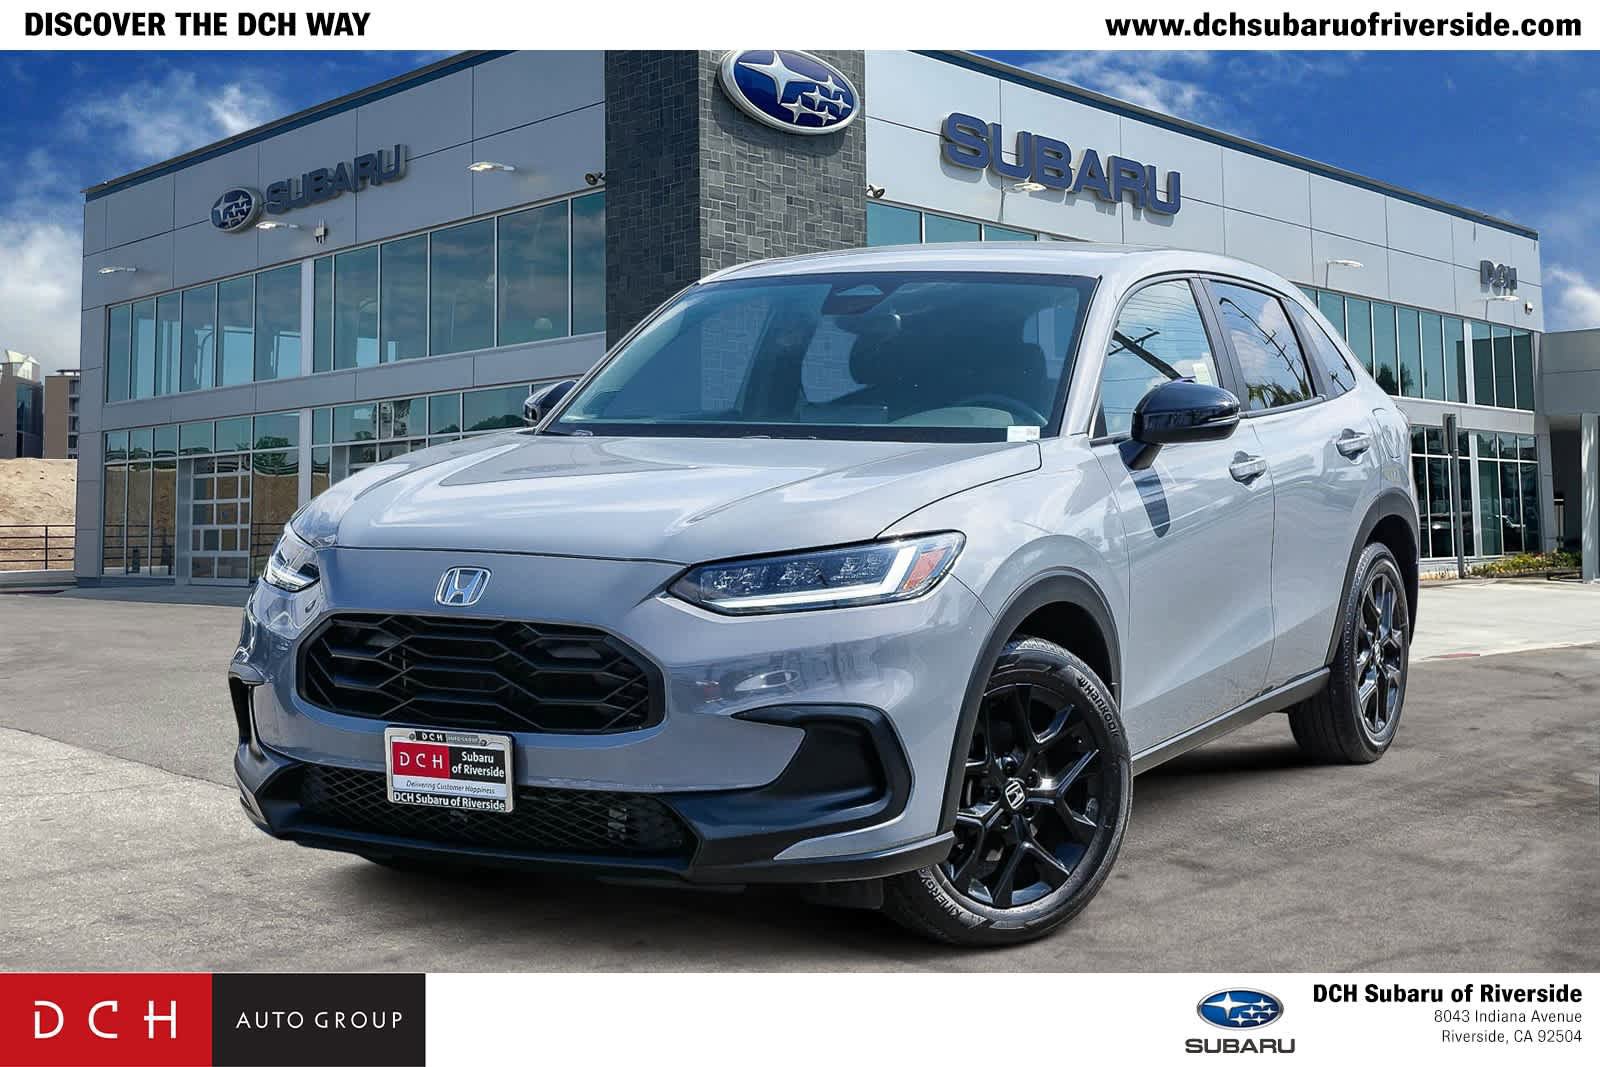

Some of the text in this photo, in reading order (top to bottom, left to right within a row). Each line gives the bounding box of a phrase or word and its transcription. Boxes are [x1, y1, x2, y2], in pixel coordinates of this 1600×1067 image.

[941, 112, 1181, 216] SUBARU
[266, 143, 408, 215] SUBARU
[421, 732, 443, 742] DCH
[399, 751, 494, 769] DCH Subaru
[451, 763, 505, 778] of Riverside
[406, 780, 436, 790] Delivering
[437, 782, 465, 792] Customer
[393, 791, 505, 811] DCH Subaru of Riverside
